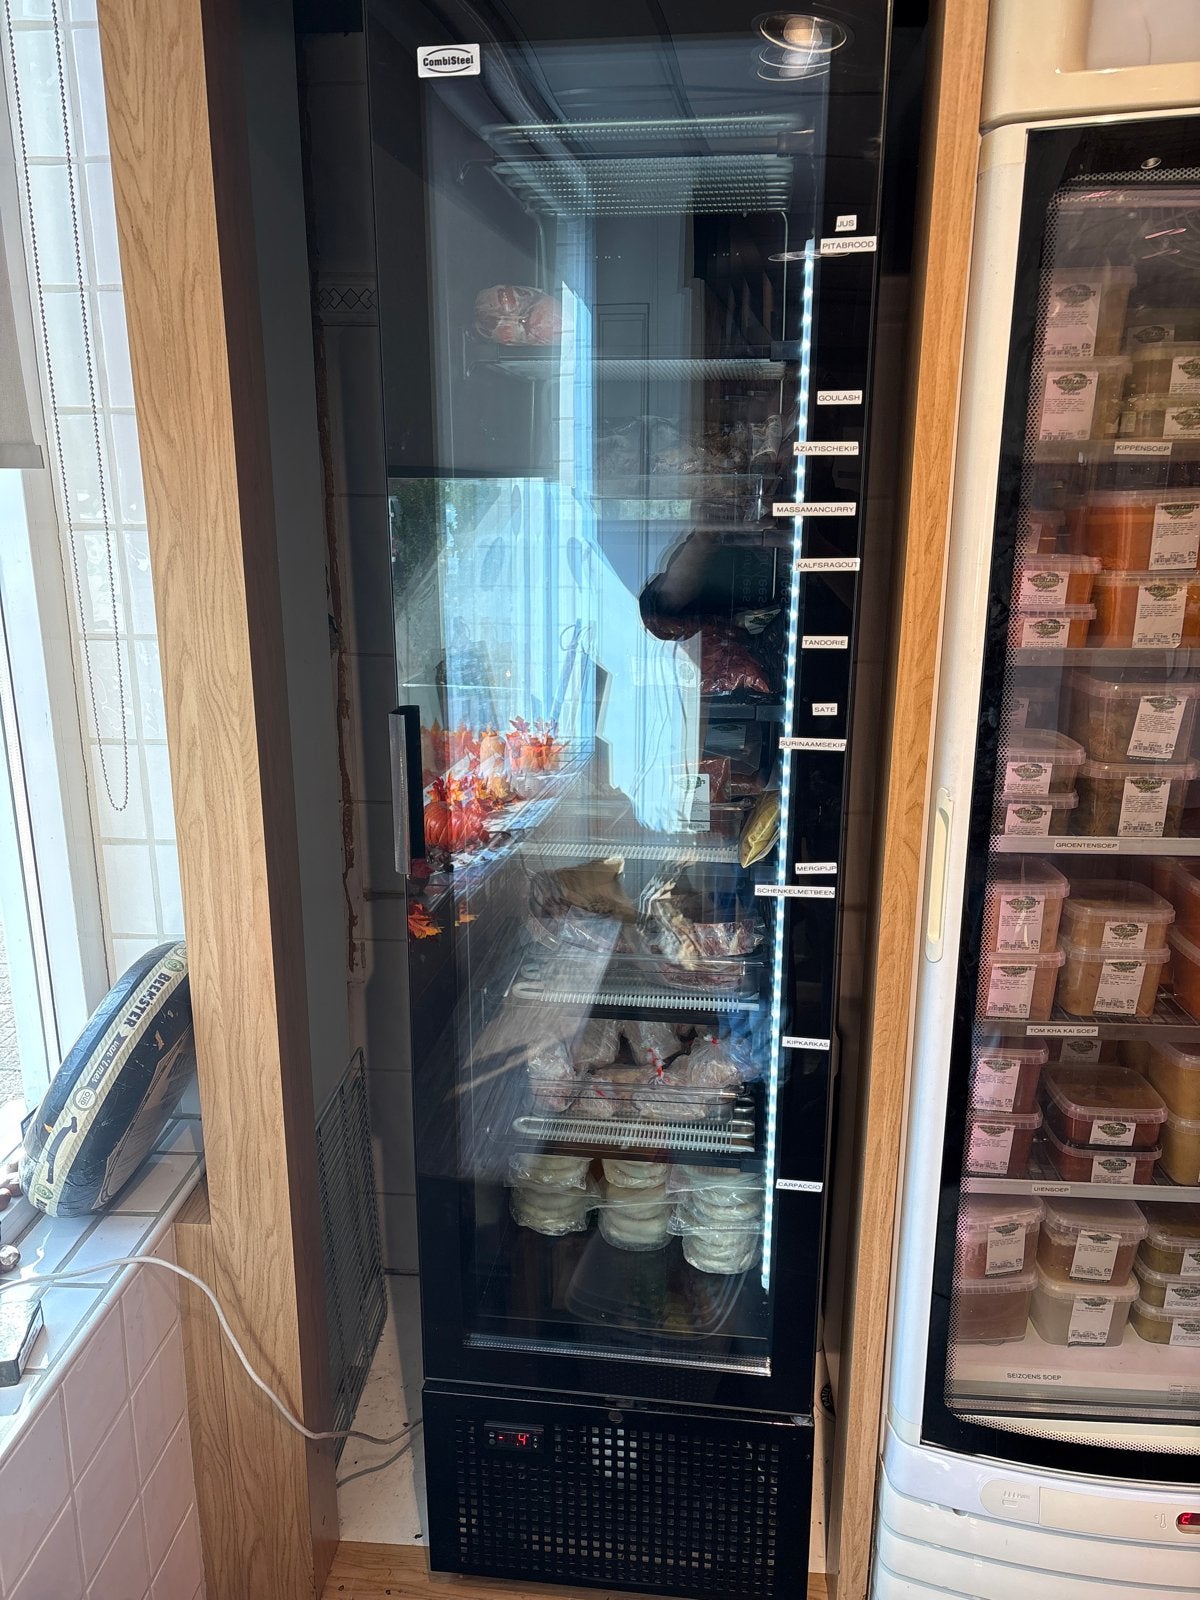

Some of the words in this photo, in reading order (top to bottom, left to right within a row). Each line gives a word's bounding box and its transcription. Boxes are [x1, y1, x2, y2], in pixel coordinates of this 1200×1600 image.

[423, 55, 474, 67] CombiSteel
[837, 219, 855, 228] JUS
[822, 240, 875, 250] PITABROOD
[818, 393, 861, 402] GOULASH
[794, 444, 859, 452] AZIATISCHEKIP
[1116, 444, 1170, 452] KIPPENSOEP
[776, 506, 855, 514] MASSAMANCURRY
[797, 561, 859, 569] KALFSRAGOUT
[780, 740, 846, 748] SURINAAMSEKIP
[756, 887, 835, 896] SCHENKELMETBEEN
[124, 972, 172, 1028] BEEMSTER
[786, 1039, 829, 1048] KIPKARKAS
[106, 1040, 120, 1059] van
[80, 1091, 91, 1106] OUD
[777, 1181, 821, 1191] CARPACCIO
[1006, 1372, 1041, 1380] SEIZOENS
